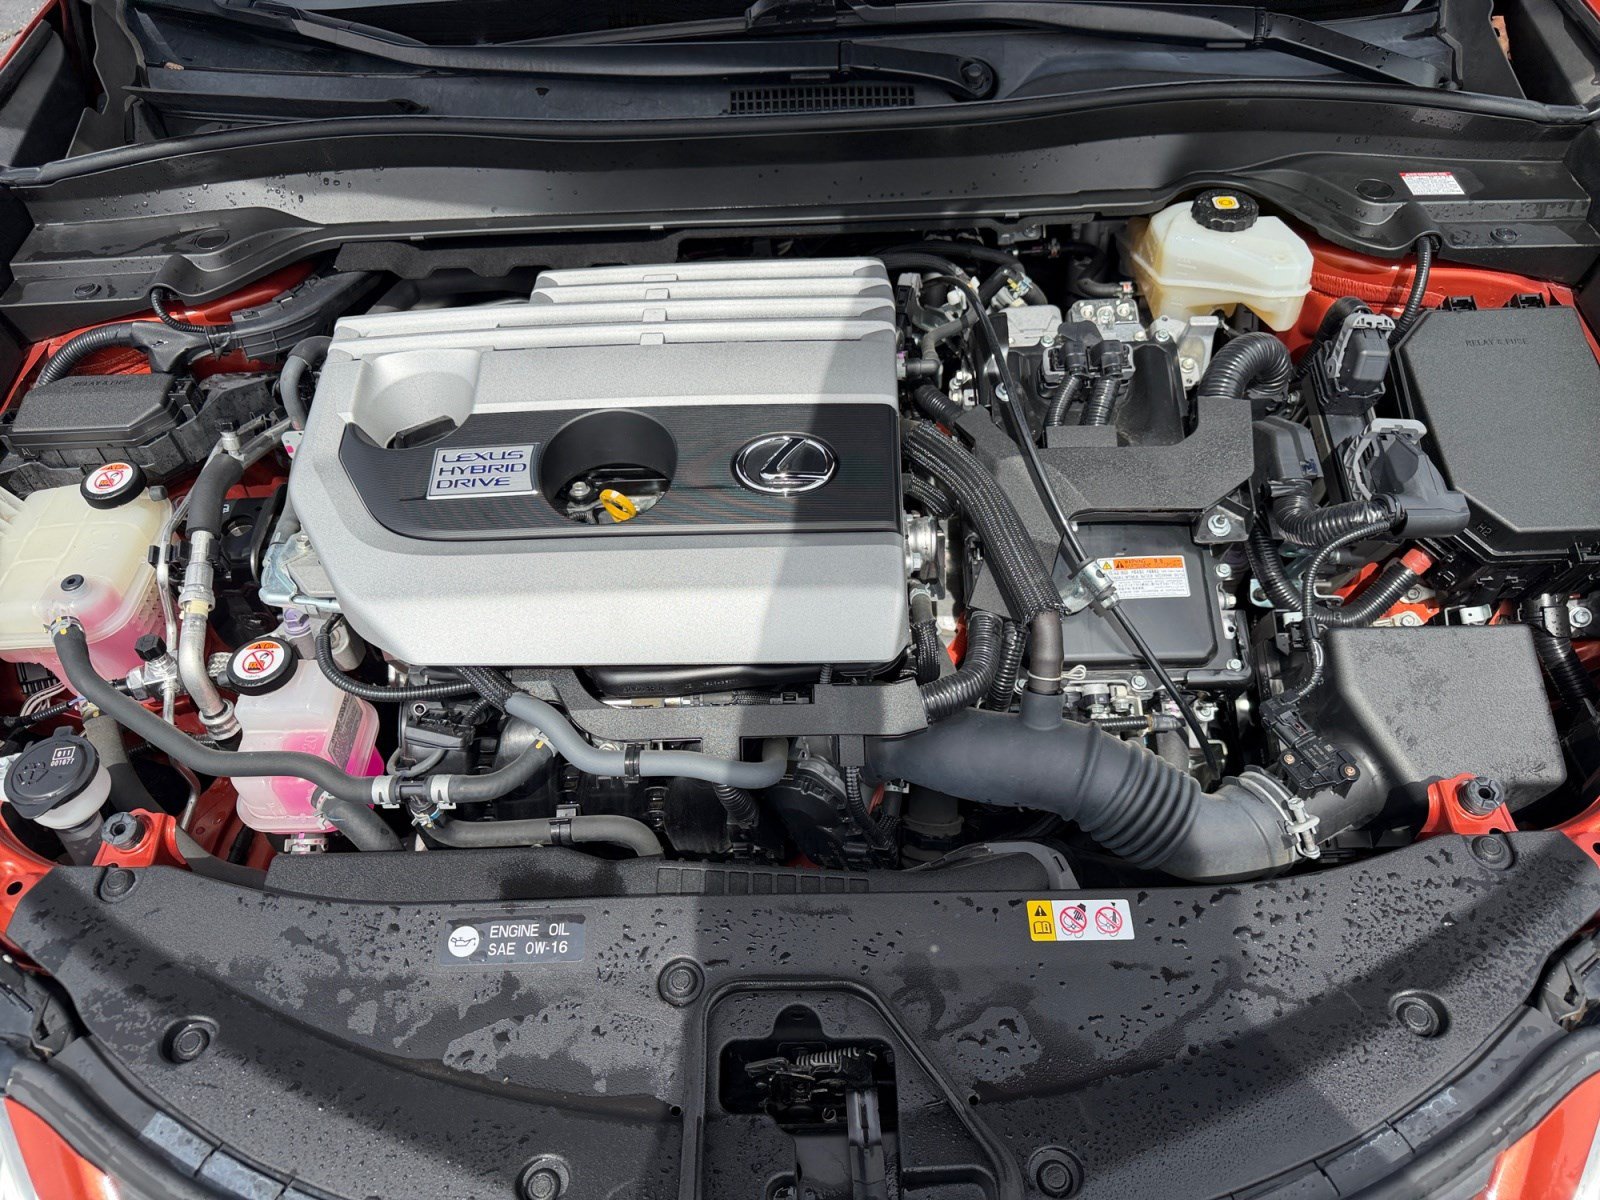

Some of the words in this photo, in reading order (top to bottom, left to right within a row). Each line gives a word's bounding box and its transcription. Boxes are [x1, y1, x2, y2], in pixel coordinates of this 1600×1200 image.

[441, 450, 523, 463] LEXUS
[438, 463, 527, 476] HYBRID
[436, 476, 511, 489] DRIVE
[489, 923, 540, 938] ENGINE
[549, 923, 570, 936] OIL
[487, 942, 516, 956] SAE
[525, 940, 568, 955] 0W-16
